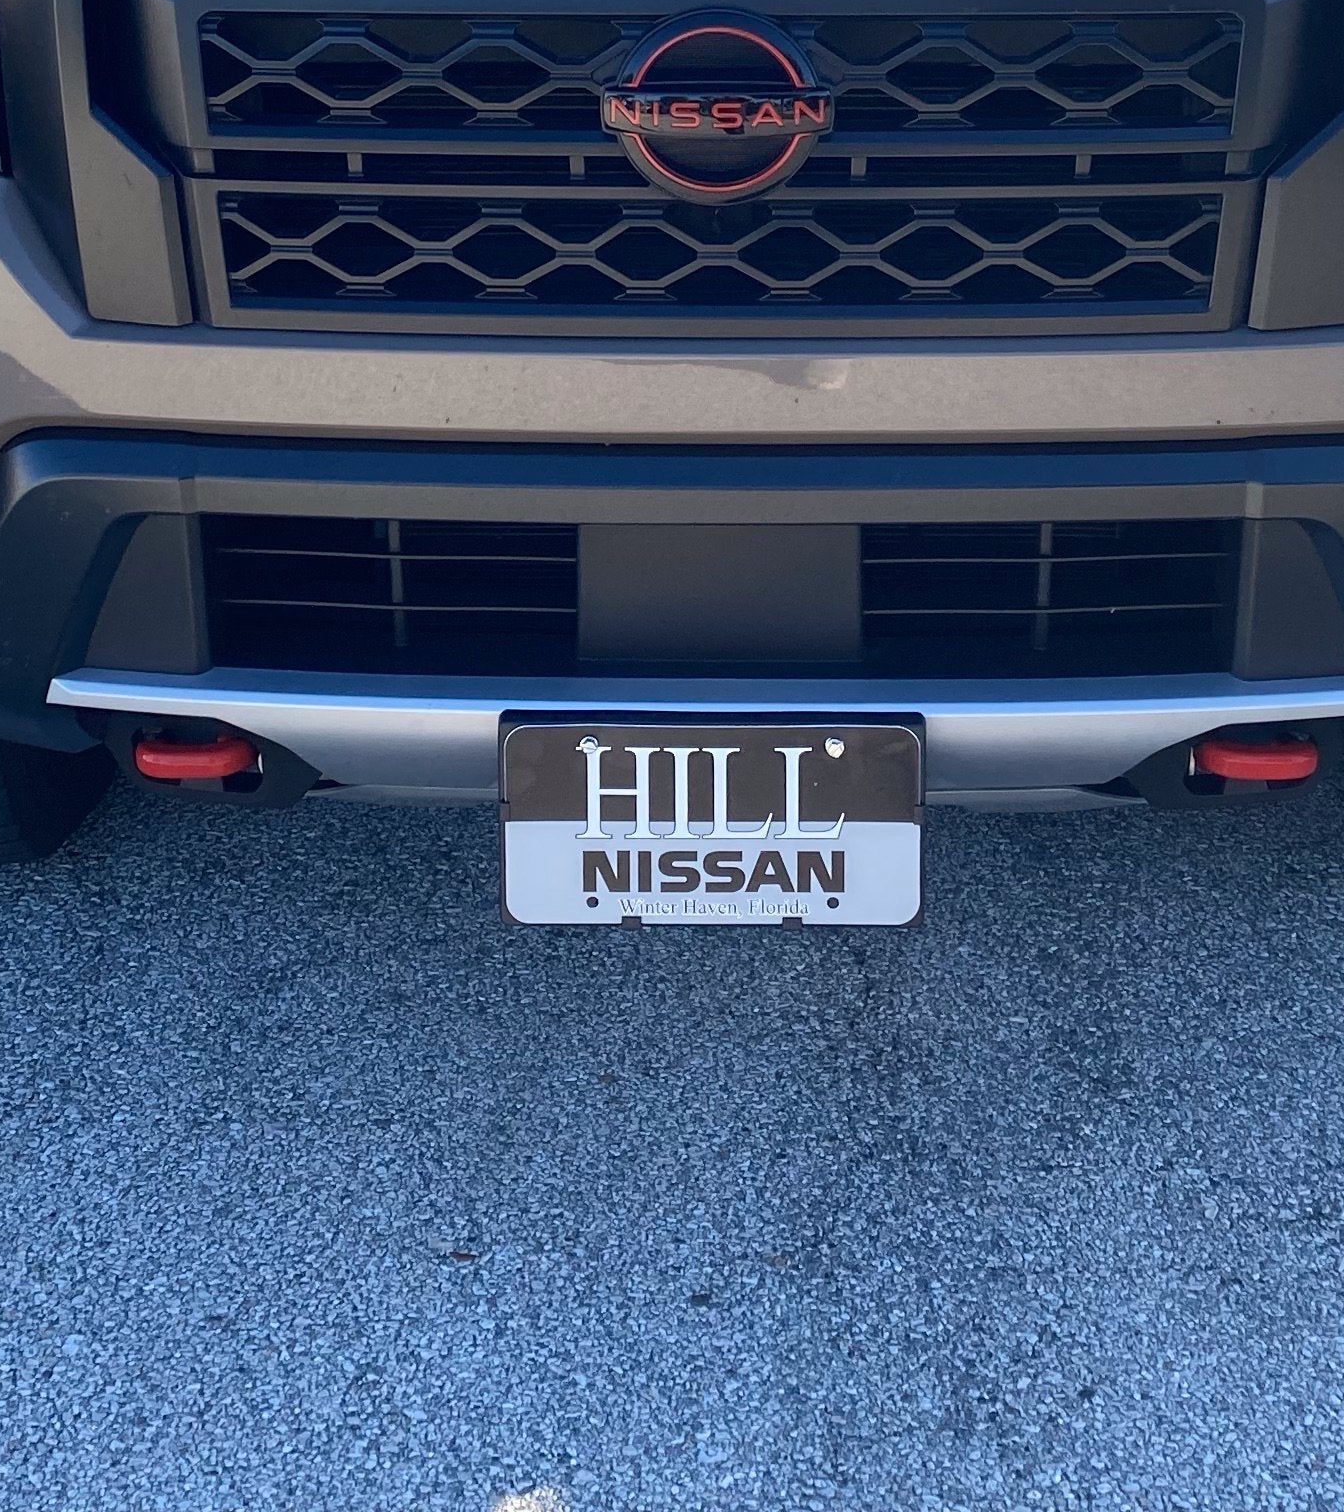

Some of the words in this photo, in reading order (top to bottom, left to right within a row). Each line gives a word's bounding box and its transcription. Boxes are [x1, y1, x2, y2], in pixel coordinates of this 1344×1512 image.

[609, 97, 826, 129] NISSAN
[575, 745, 846, 840] HILL
[582, 850, 845, 894] NISSAN
[620, 899, 677, 915] Winter
[684, 899, 742, 918] Haven,
[749, 899, 809, 915] Florida
